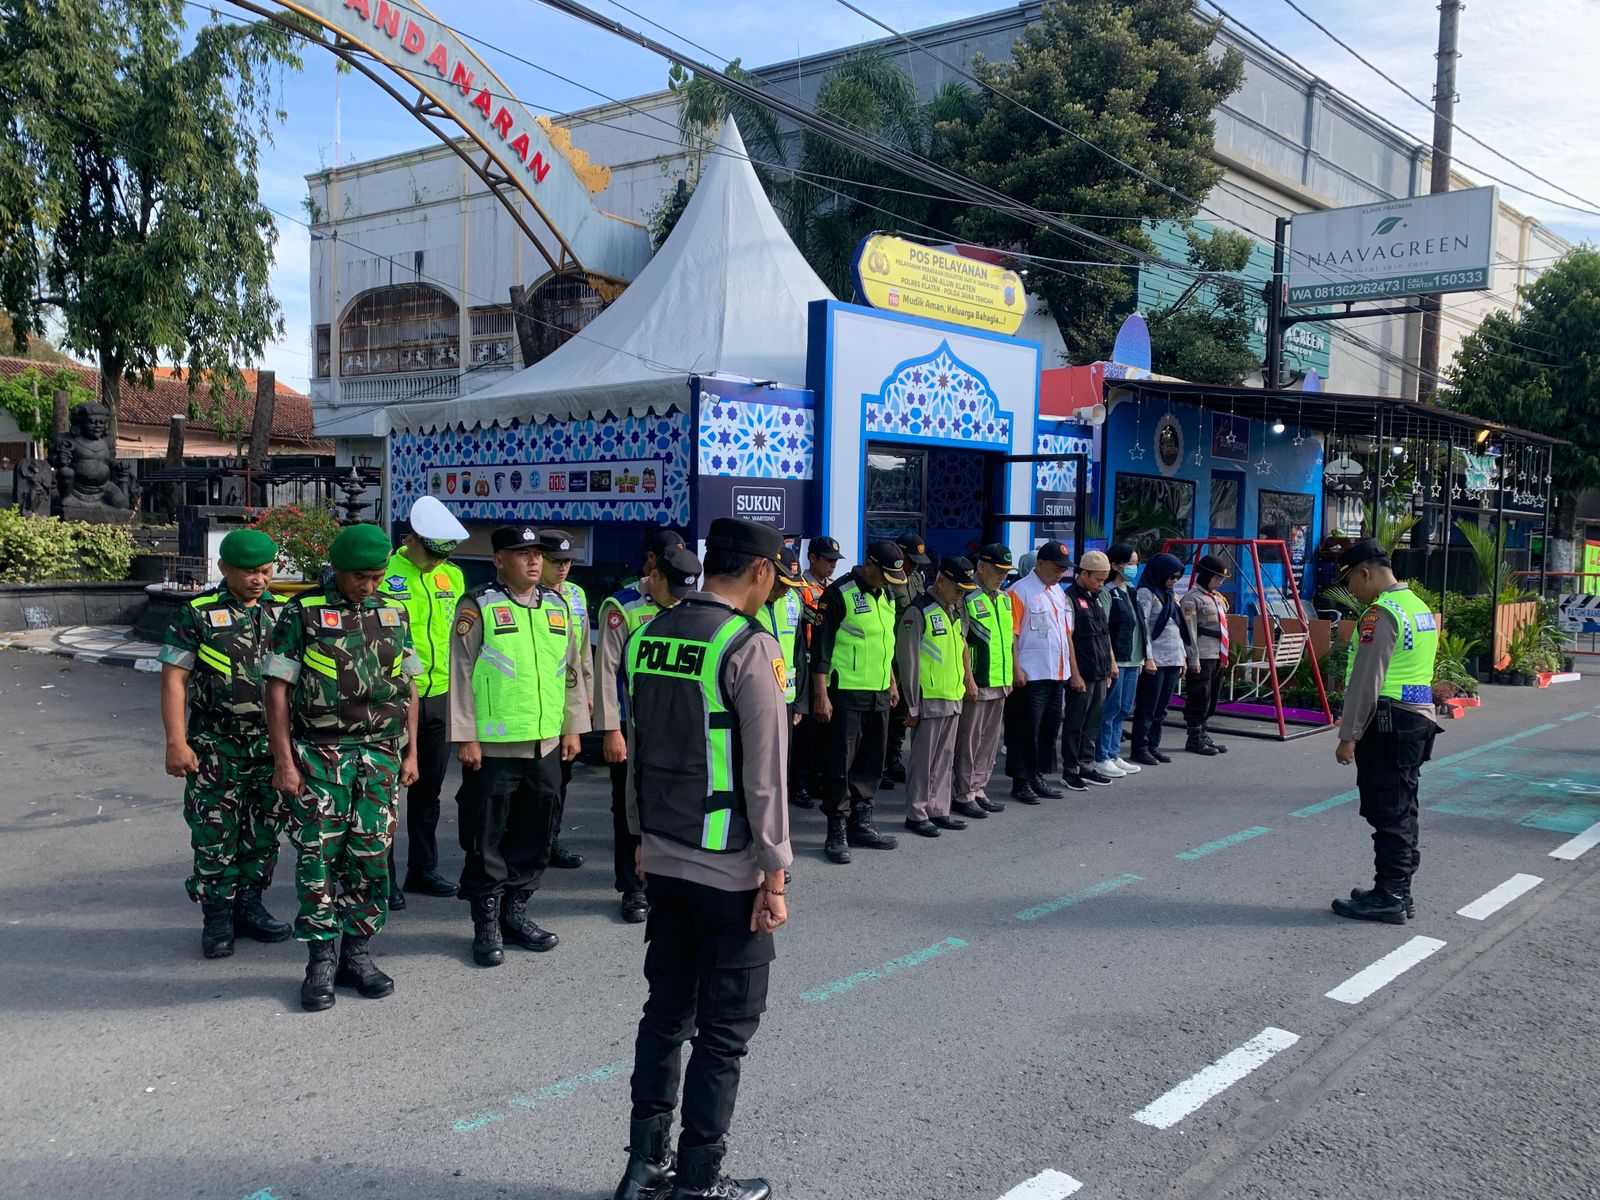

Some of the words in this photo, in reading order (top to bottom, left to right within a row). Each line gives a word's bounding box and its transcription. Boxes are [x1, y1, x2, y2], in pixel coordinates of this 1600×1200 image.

[1307, 234, 1469, 268] NAAVAGREEN
[909, 248, 930, 265] POS
[932, 254, 988, 280] PELAYANAN
[921, 274, 954, 289] ALUN-ALUN
[954, 281, 976, 293] KLATEN
[1433, 270, 1483, 287] 150333
[900, 276, 921, 288] POLRES
[921, 282, 941, 293] KLATEN
[944, 287, 960, 297] POLDA
[960, 291, 975, 300] JAWA
[975, 295, 994, 304] TENGAH
[1292, 288, 1312, 300] WA
[1315, 279, 1400, 298] 081362262473
[902, 293, 924, 307] Mudik
[925, 300, 946, 313] Aman,
[946, 303, 975, 320] Keluarga
[549, 475, 565, 490] 110
[736, 494, 781, 511] SUKUN
[1045, 505, 1072, 516] SUKUN
[636, 640, 706, 676] POLISI
